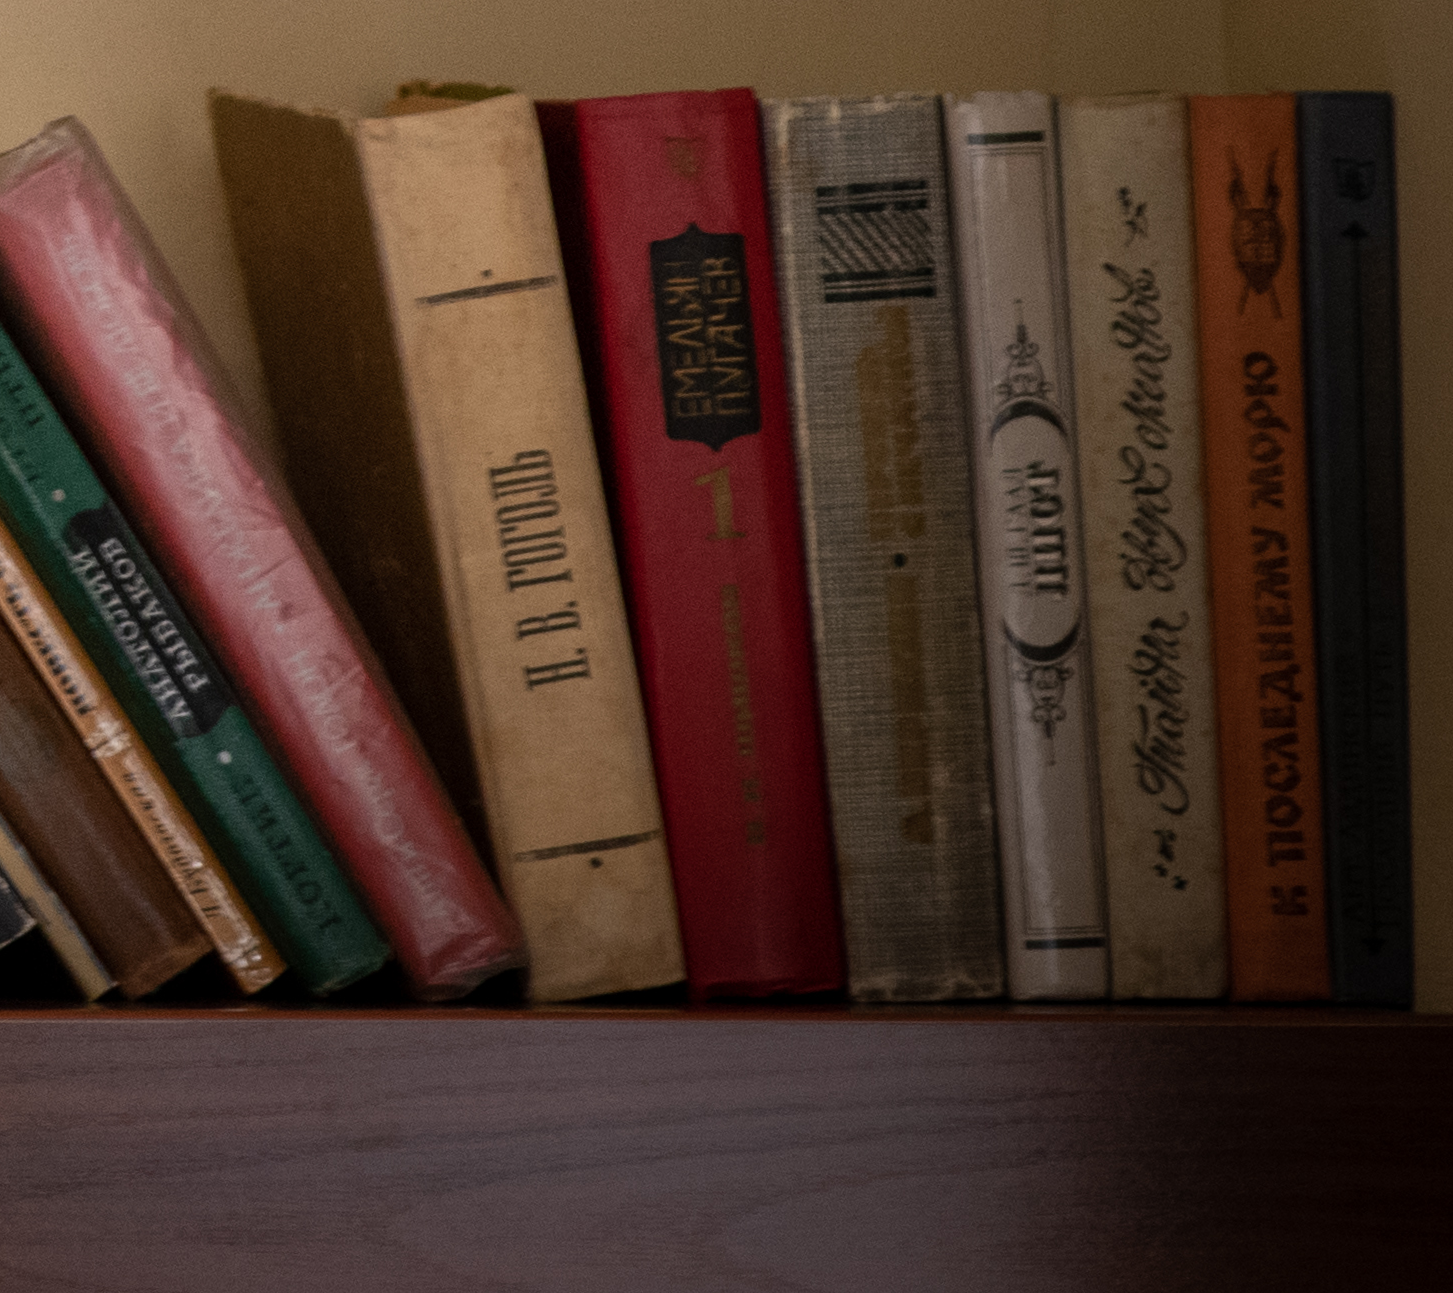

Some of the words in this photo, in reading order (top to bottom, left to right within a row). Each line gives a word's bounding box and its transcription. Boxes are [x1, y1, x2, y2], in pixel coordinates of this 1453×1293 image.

[1240, 348, 1294, 511] МОРЮ
[483, 447, 573, 593] ГОГОЛЬ
[64, 545, 192, 724] АНАТОЛИЙ
[98, 534, 211, 693] РЫБАКОВ
[510, 600, 581, 639] В.
[518, 647, 591, 691] Н.
[1249, 523, 1312, 867] ПОСЛЕДНЕМУ
[1269, 884, 1309, 917] К
